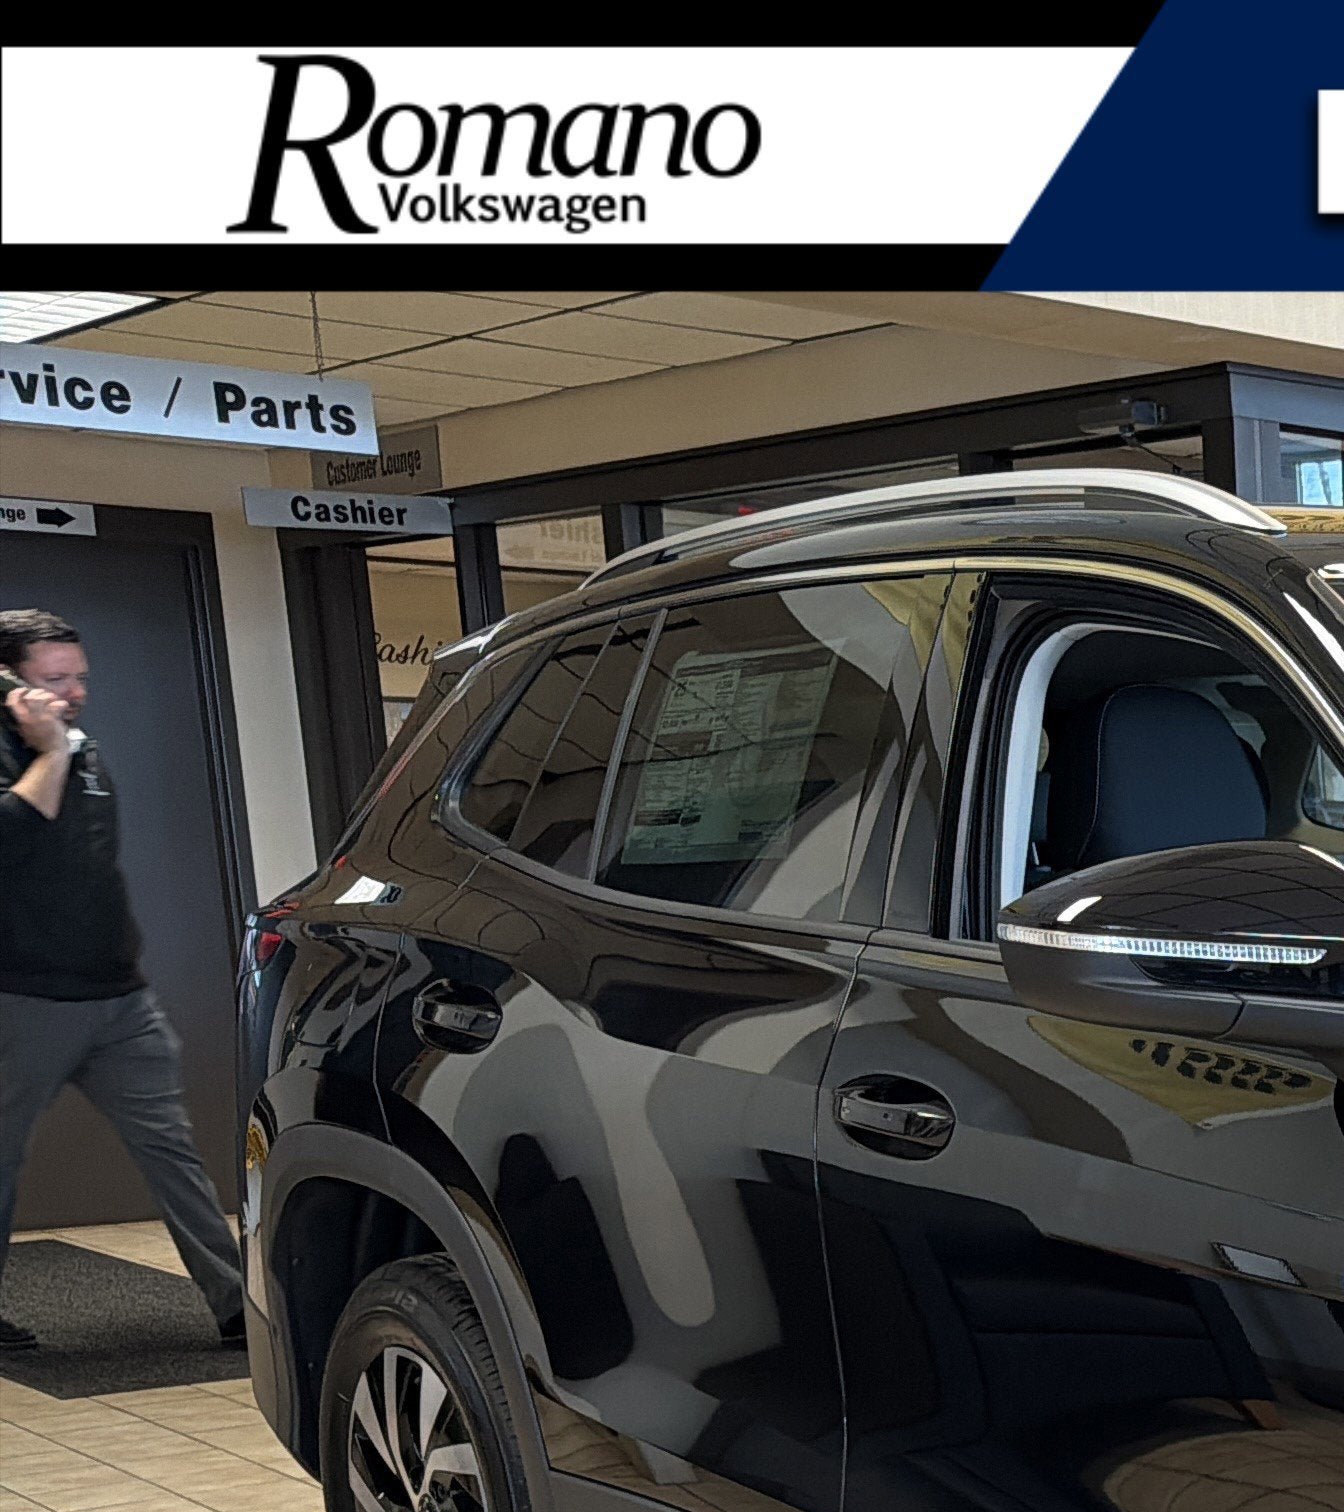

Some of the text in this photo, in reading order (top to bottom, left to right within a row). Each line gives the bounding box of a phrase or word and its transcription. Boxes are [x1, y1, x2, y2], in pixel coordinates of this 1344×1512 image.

[0, 363, 131, 415] vice
[212, 380, 357, 436] Parts
[326, 449, 422, 486] Customer Lounge
[290, 495, 408, 525] Cashier
